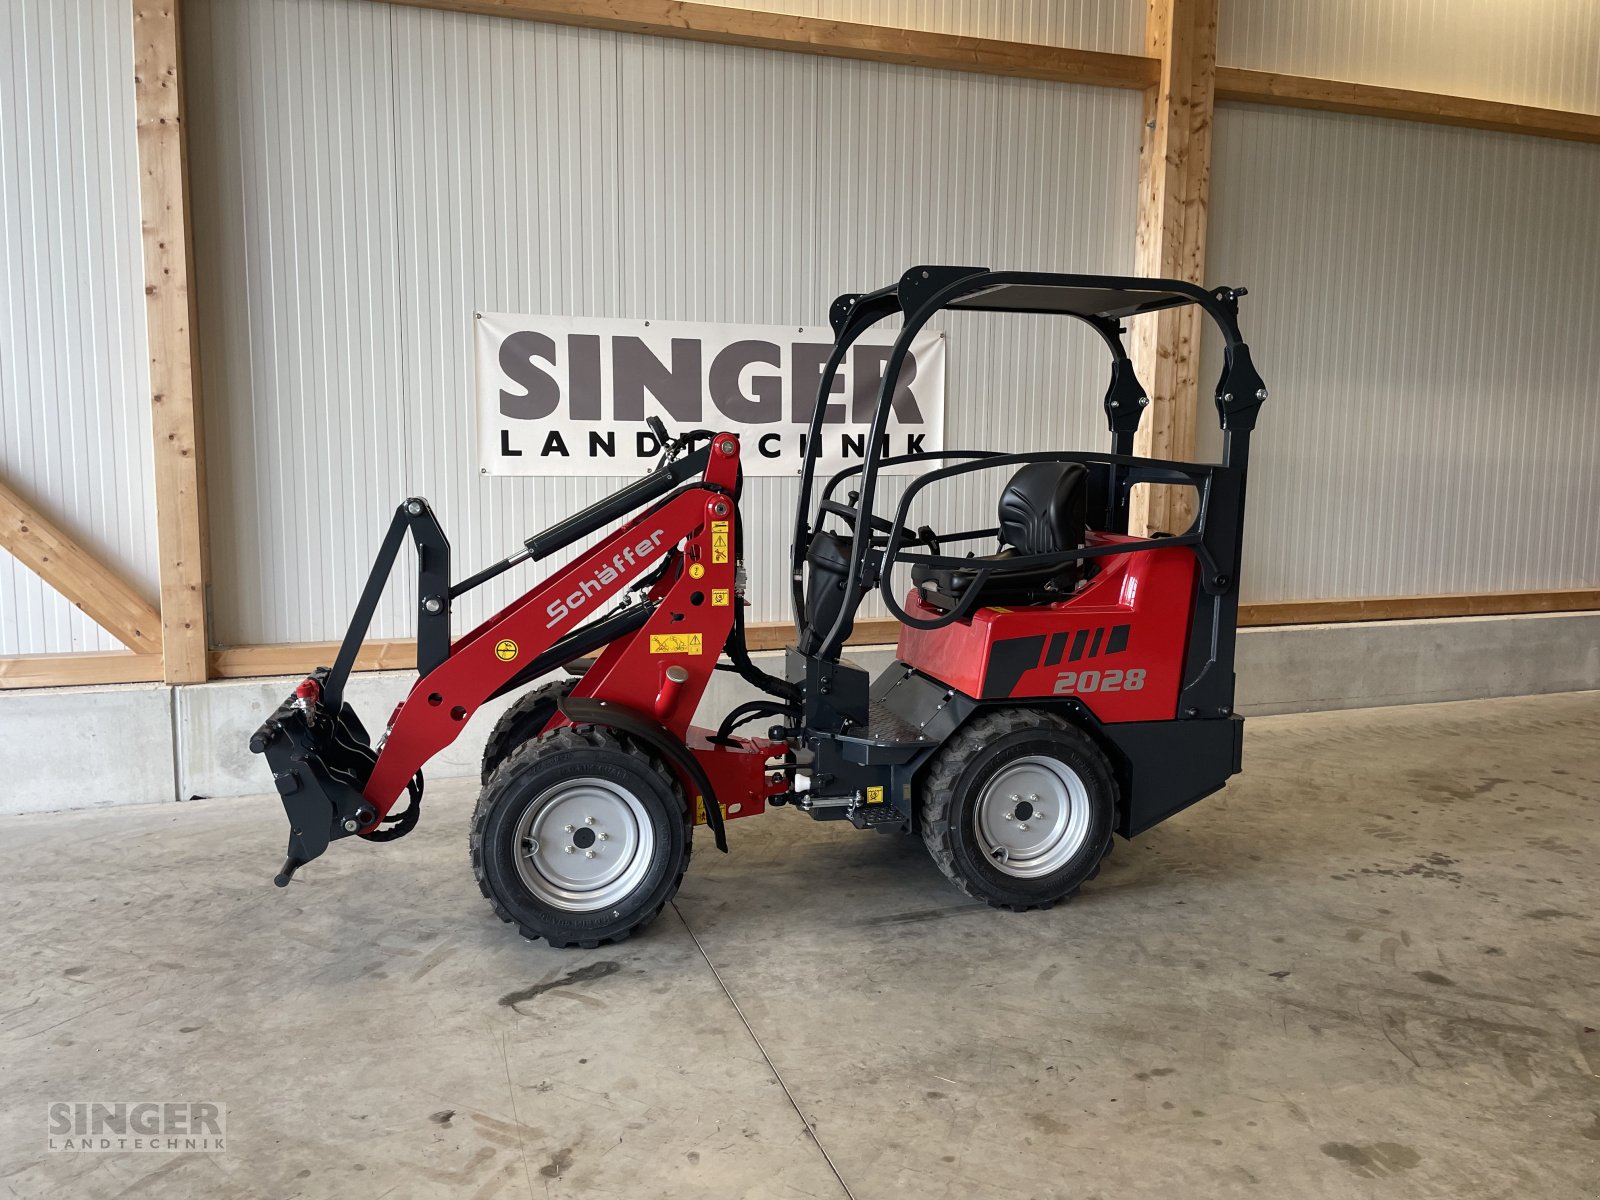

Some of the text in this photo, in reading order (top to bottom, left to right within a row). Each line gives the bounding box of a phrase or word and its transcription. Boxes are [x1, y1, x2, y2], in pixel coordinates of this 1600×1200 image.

[499, 330, 924, 424] SINGER
[501, 430, 926, 459] LANDTCHNIK
[545, 528, 665, 629] Schäffer
[1053, 668, 1146, 694] 2028
